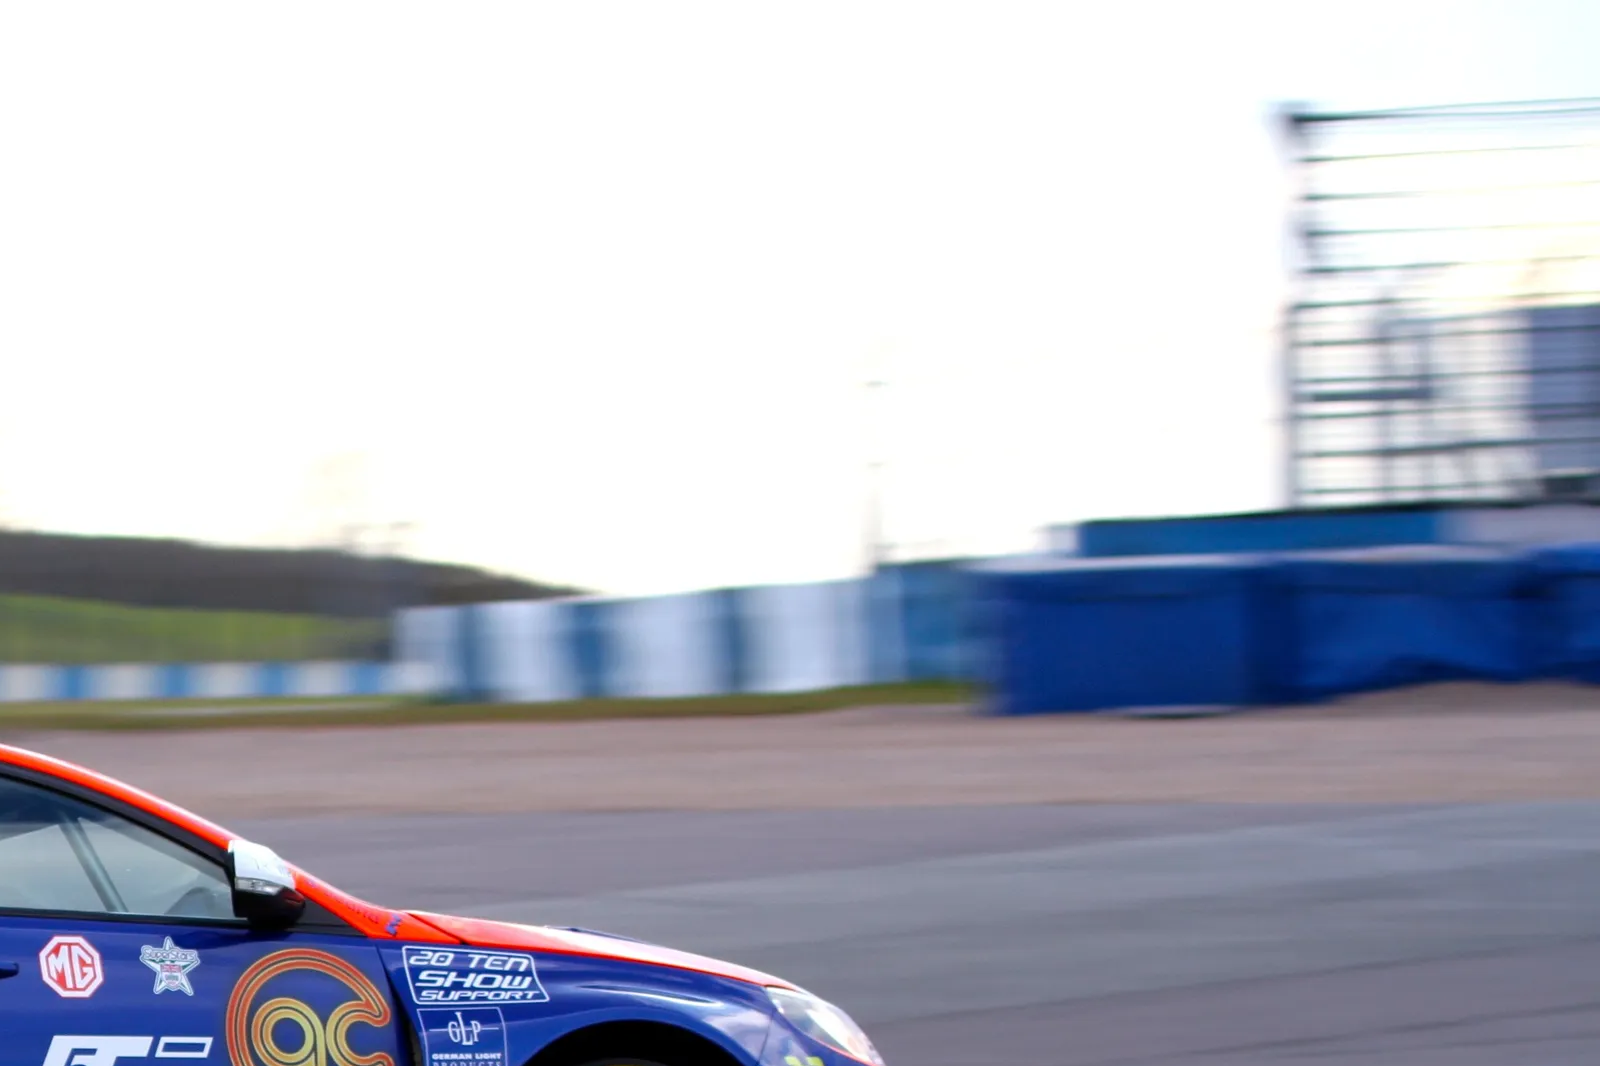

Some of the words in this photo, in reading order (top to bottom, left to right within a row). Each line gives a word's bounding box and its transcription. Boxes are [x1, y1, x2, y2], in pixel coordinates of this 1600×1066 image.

[47, 943, 95, 989] MG
[409, 950, 455, 967] 20
[468, 954, 530, 972] TEN
[415, 970, 532, 989] SHOW
[419, 990, 540, 1001] SUPPORT
[448, 1012, 481, 1045] GLP
